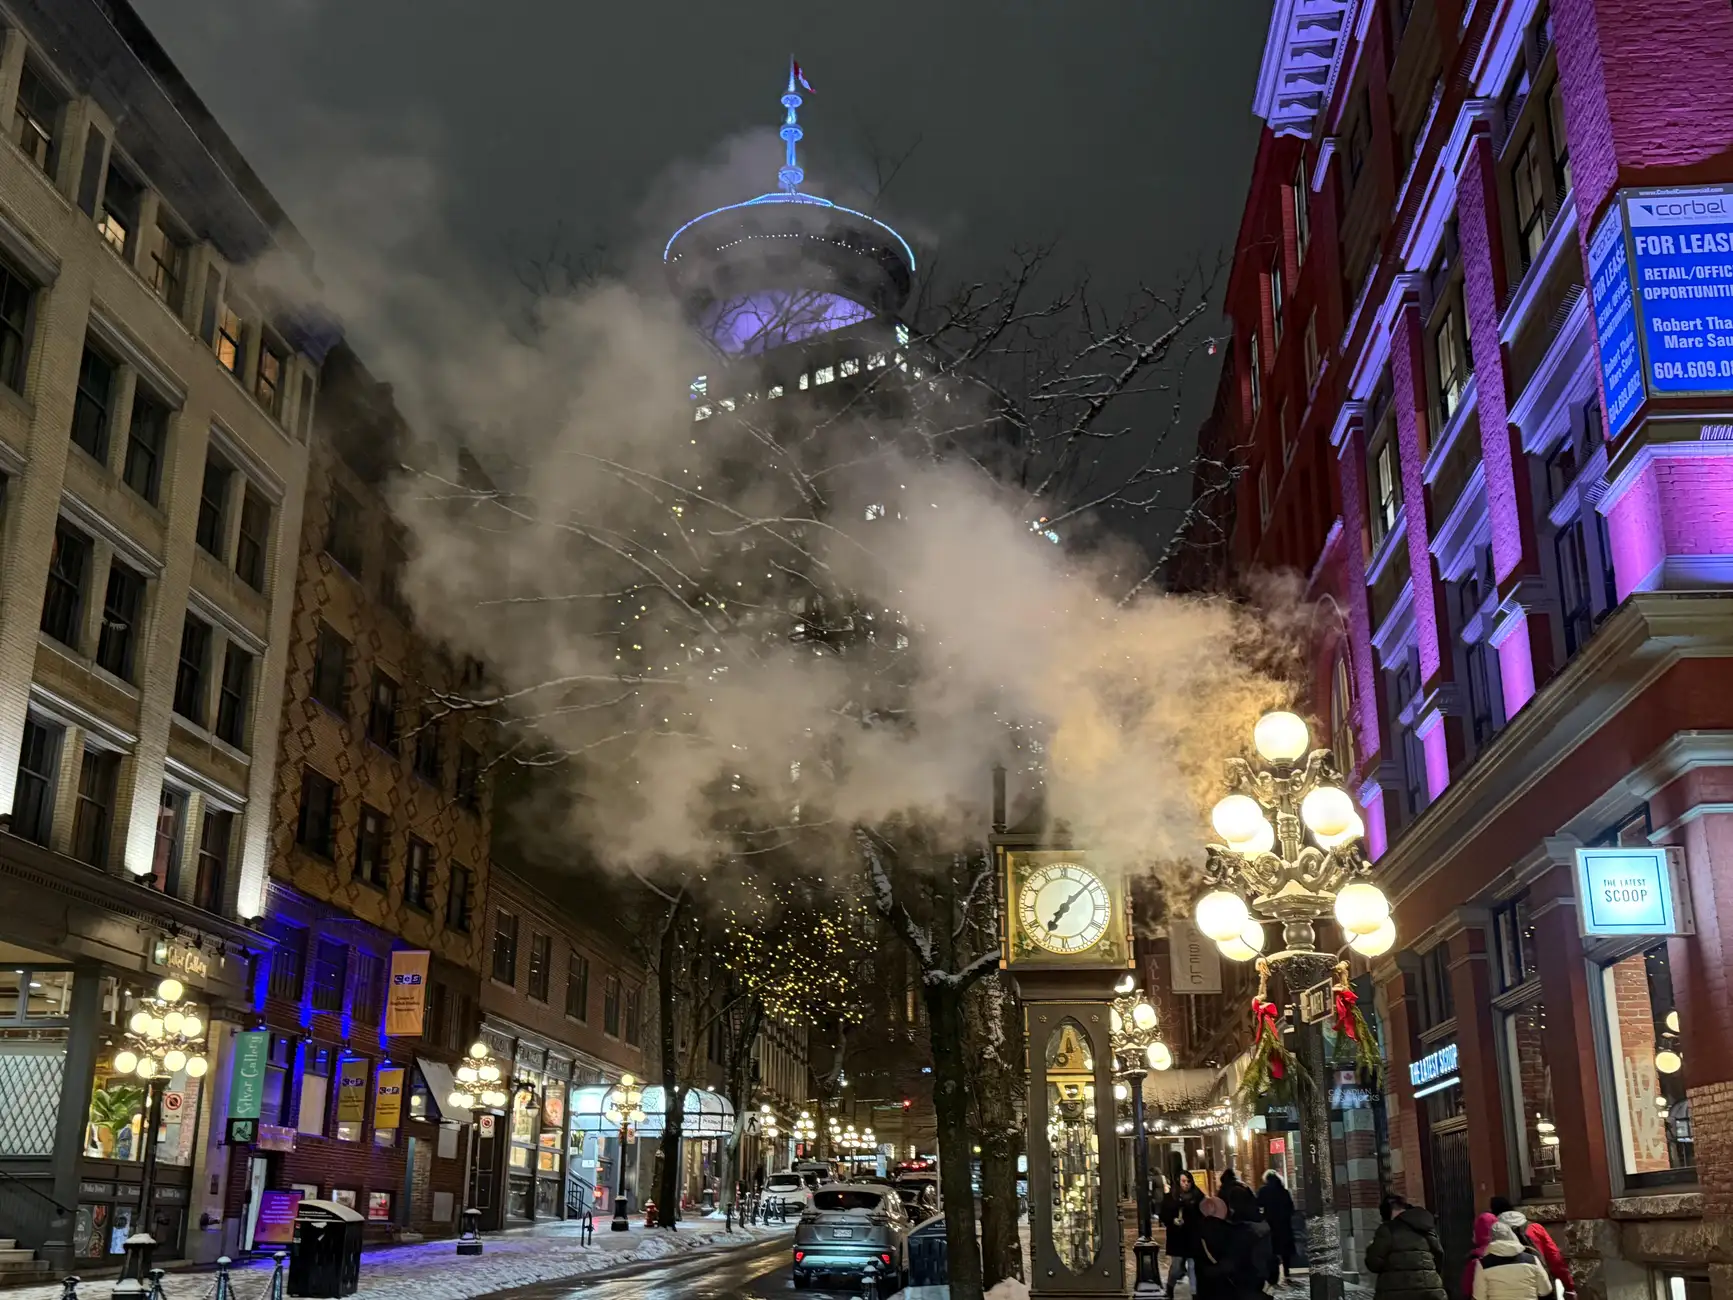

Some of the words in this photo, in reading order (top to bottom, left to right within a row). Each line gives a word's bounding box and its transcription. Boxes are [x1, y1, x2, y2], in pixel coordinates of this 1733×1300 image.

[1656, 199, 1727, 216] corbel
[1635, 235, 1675, 255] FOR
[1593, 276, 1606, 307] FOR
[1605, 243, 1626, 287] LEASE
[1644, 265, 1733, 280] RETAIL/OFFIC
[1652, 317, 1704, 332] Robert
[1664, 335, 1704, 349] Marc
[1603, 879, 1616, 887] THE
[1620, 879, 1646, 887] LATEST
[1604, 889, 1648, 903] SCOOP
[240, 1035, 263, 1078] Gallery
[1438, 1044, 1458, 1074] SCOOP
[237, 1081, 254, 1114] Silver
